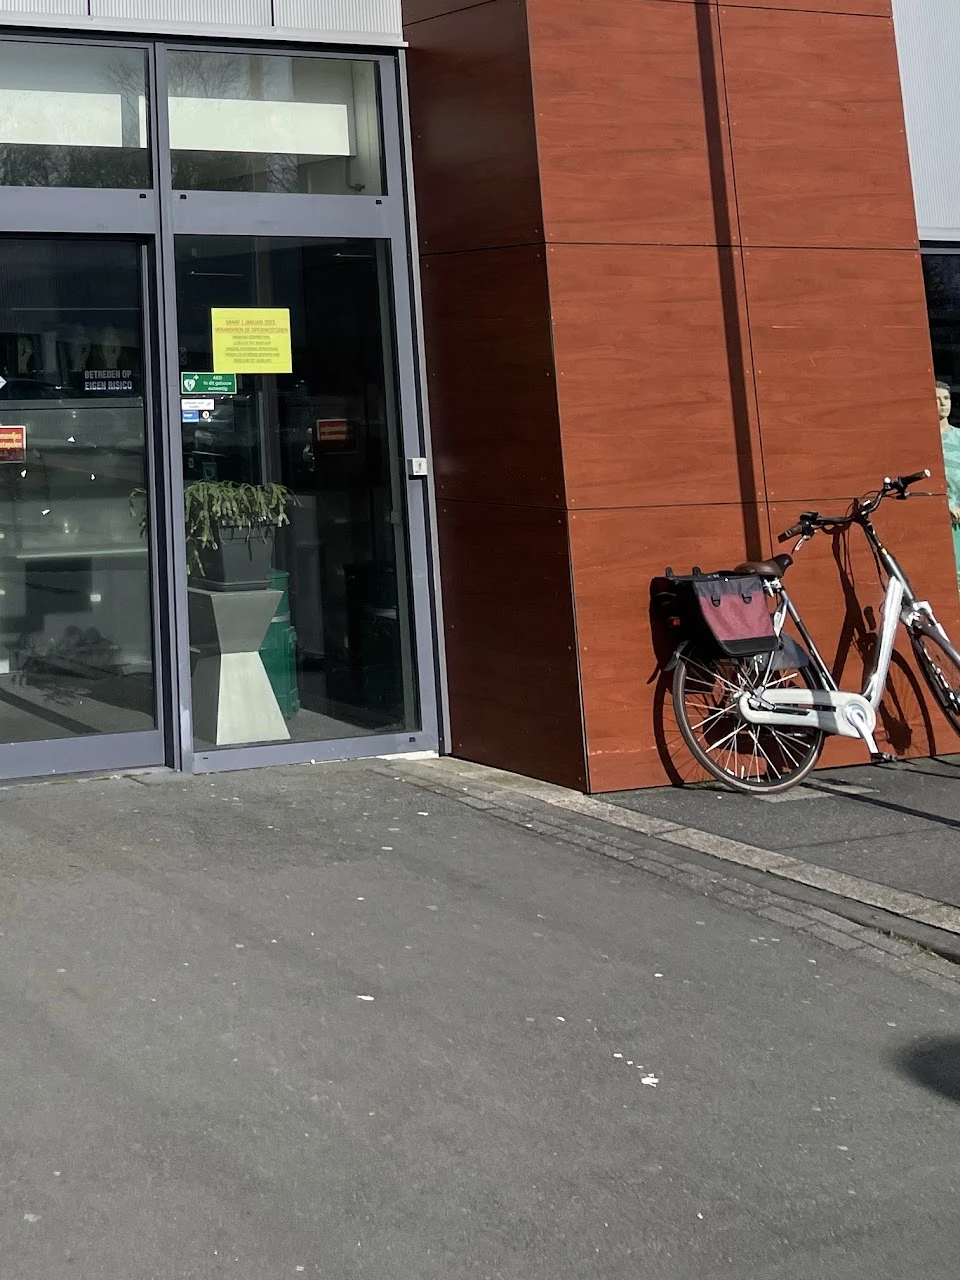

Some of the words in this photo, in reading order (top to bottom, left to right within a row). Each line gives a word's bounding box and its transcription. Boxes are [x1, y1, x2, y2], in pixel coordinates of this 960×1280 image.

[84, 370, 121, 379] BETREDEN
[121, 370, 132, 379] OP
[84, 381, 107, 390] EIGEN
[107, 380, 133, 390] RISICO
